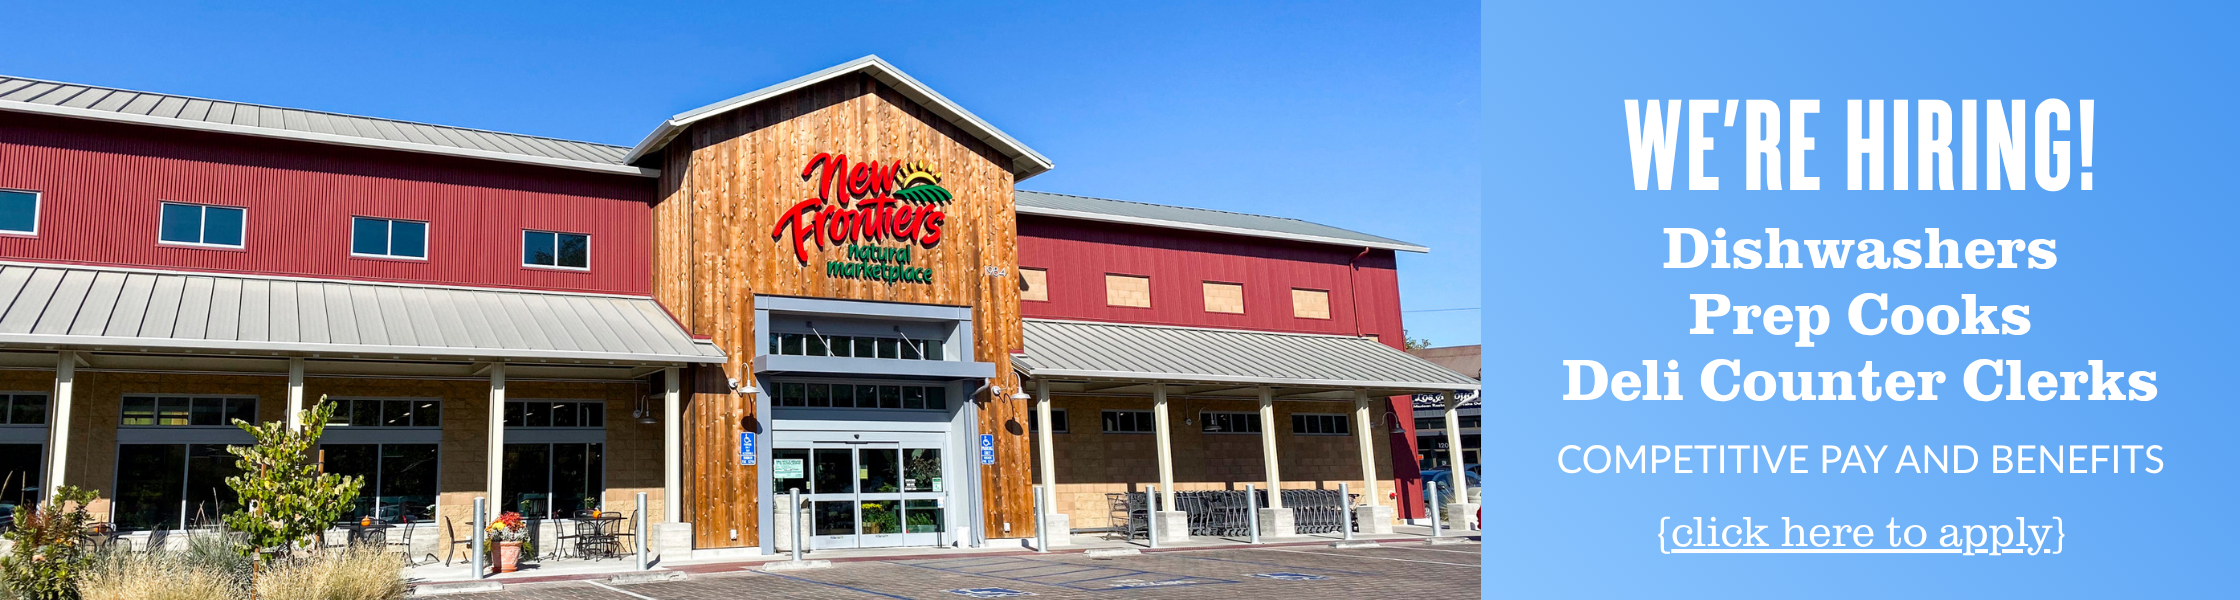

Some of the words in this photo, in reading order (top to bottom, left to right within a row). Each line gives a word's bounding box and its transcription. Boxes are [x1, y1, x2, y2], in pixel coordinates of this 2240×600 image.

[802, 152, 901, 205] New
[772, 192, 946, 262] Frontiers
[848, 243, 911, 264] natural
[826, 260, 933, 284] marketplace
[983, 265, 1007, 278] 1984
